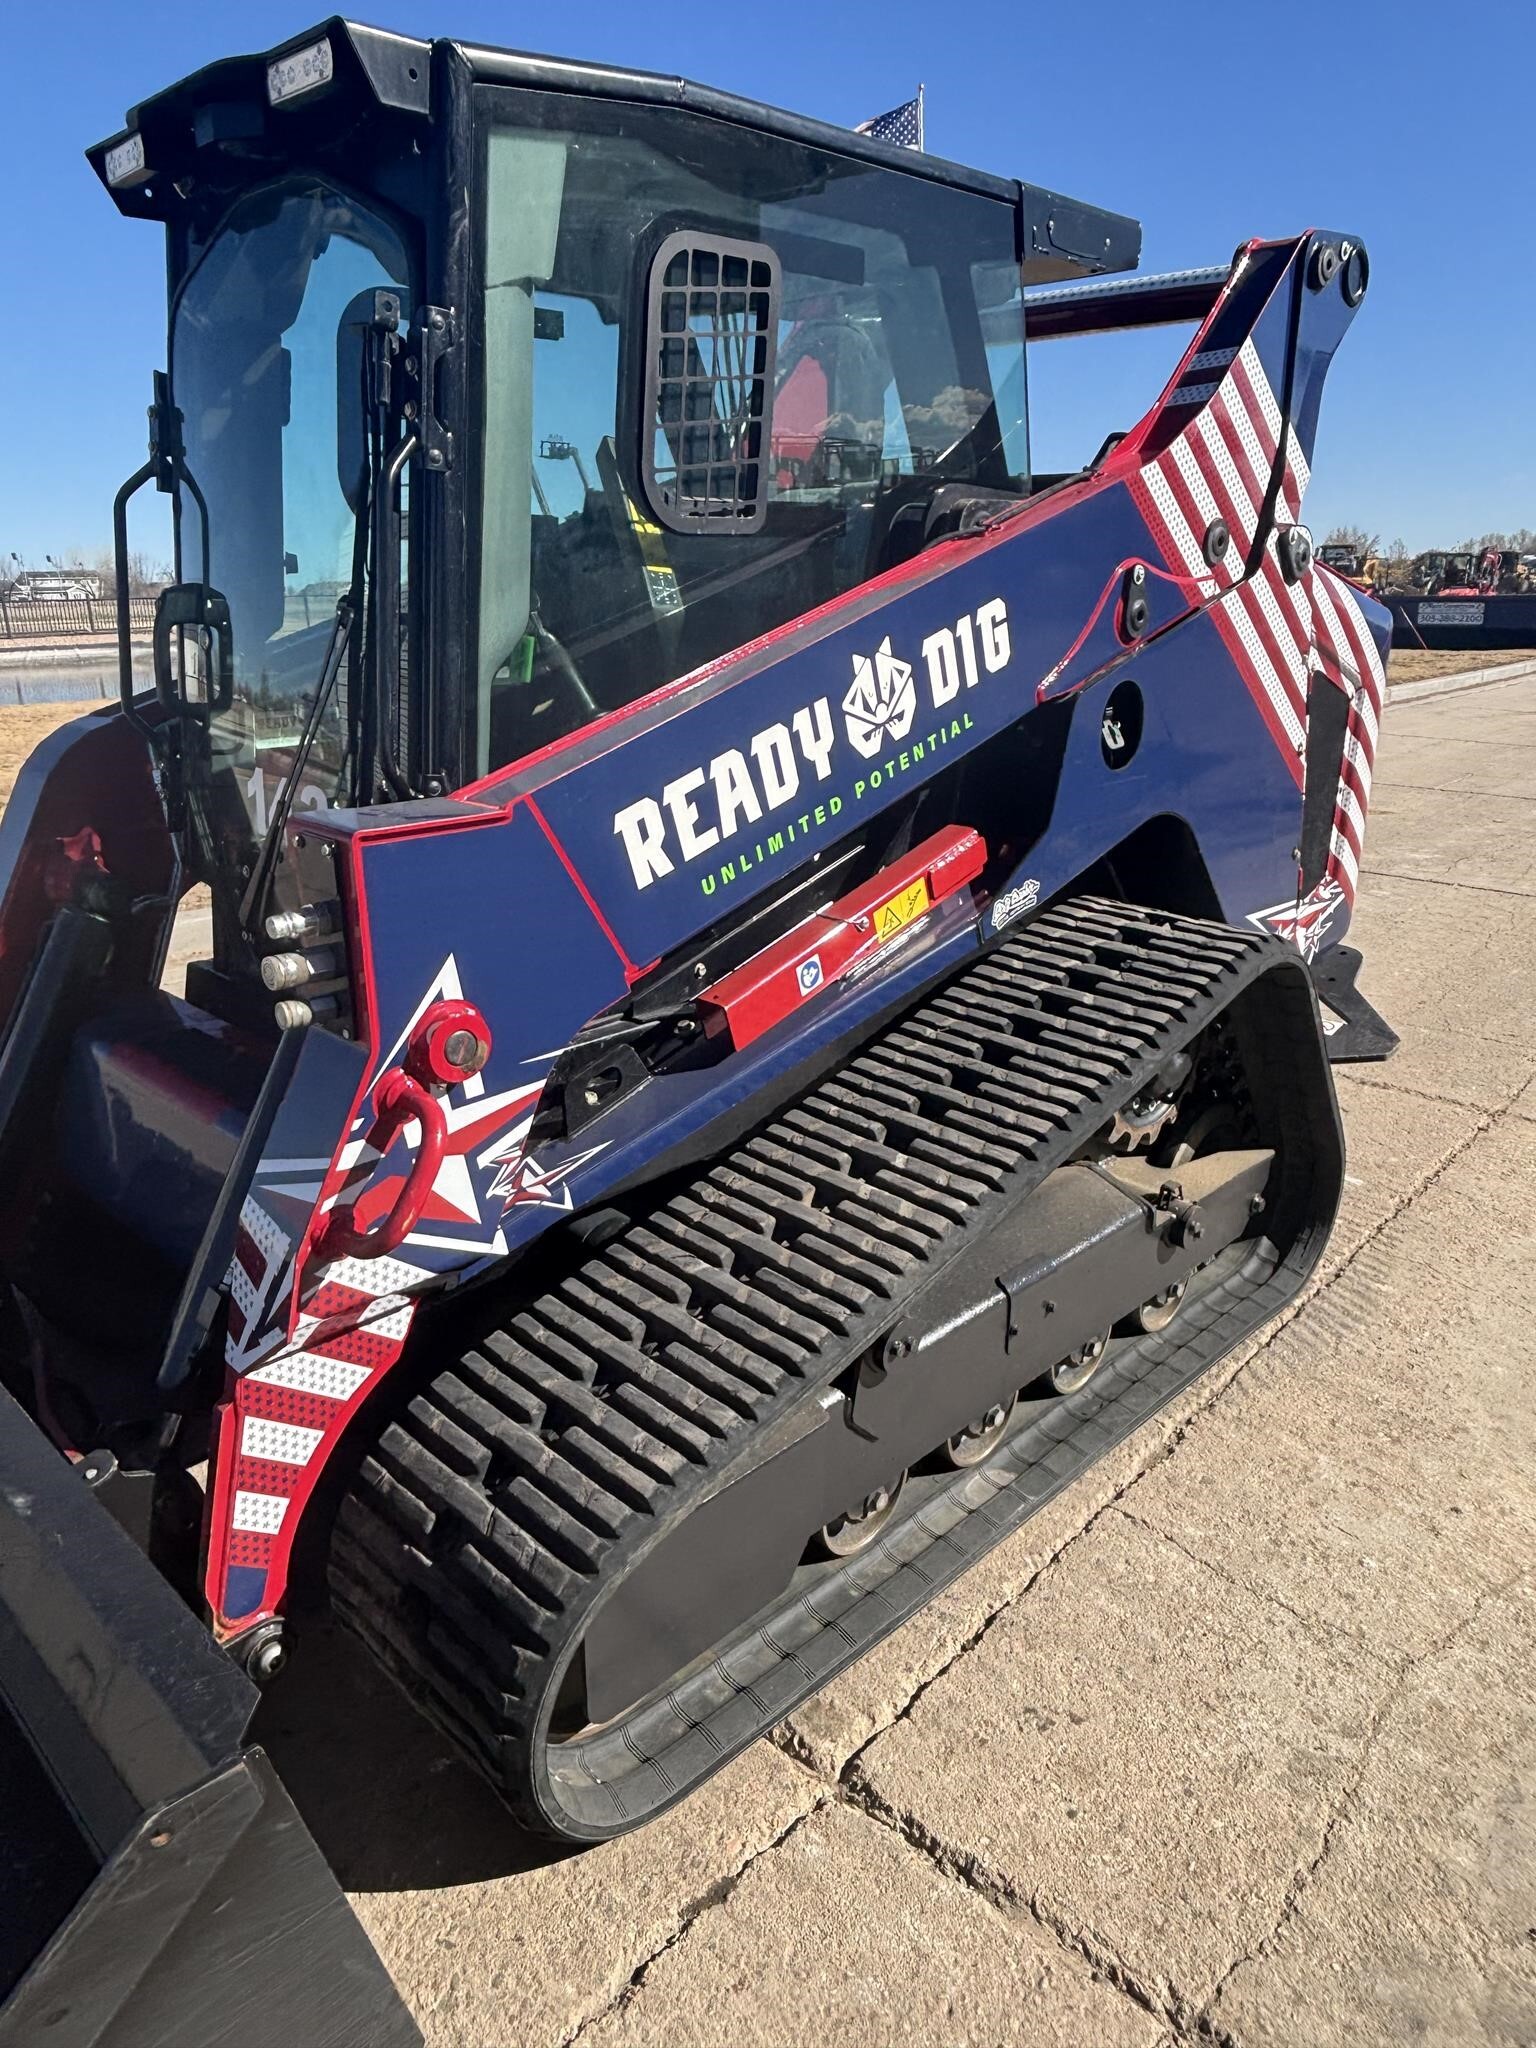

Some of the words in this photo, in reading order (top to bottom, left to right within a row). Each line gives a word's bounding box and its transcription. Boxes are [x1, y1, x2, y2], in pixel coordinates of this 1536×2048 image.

[613, 696, 835, 890] READY
[921, 597, 1011, 709] DIG
[702, 795, 842, 895] UNLIMITED
[854, 712, 974, 799] POTENTIAL
